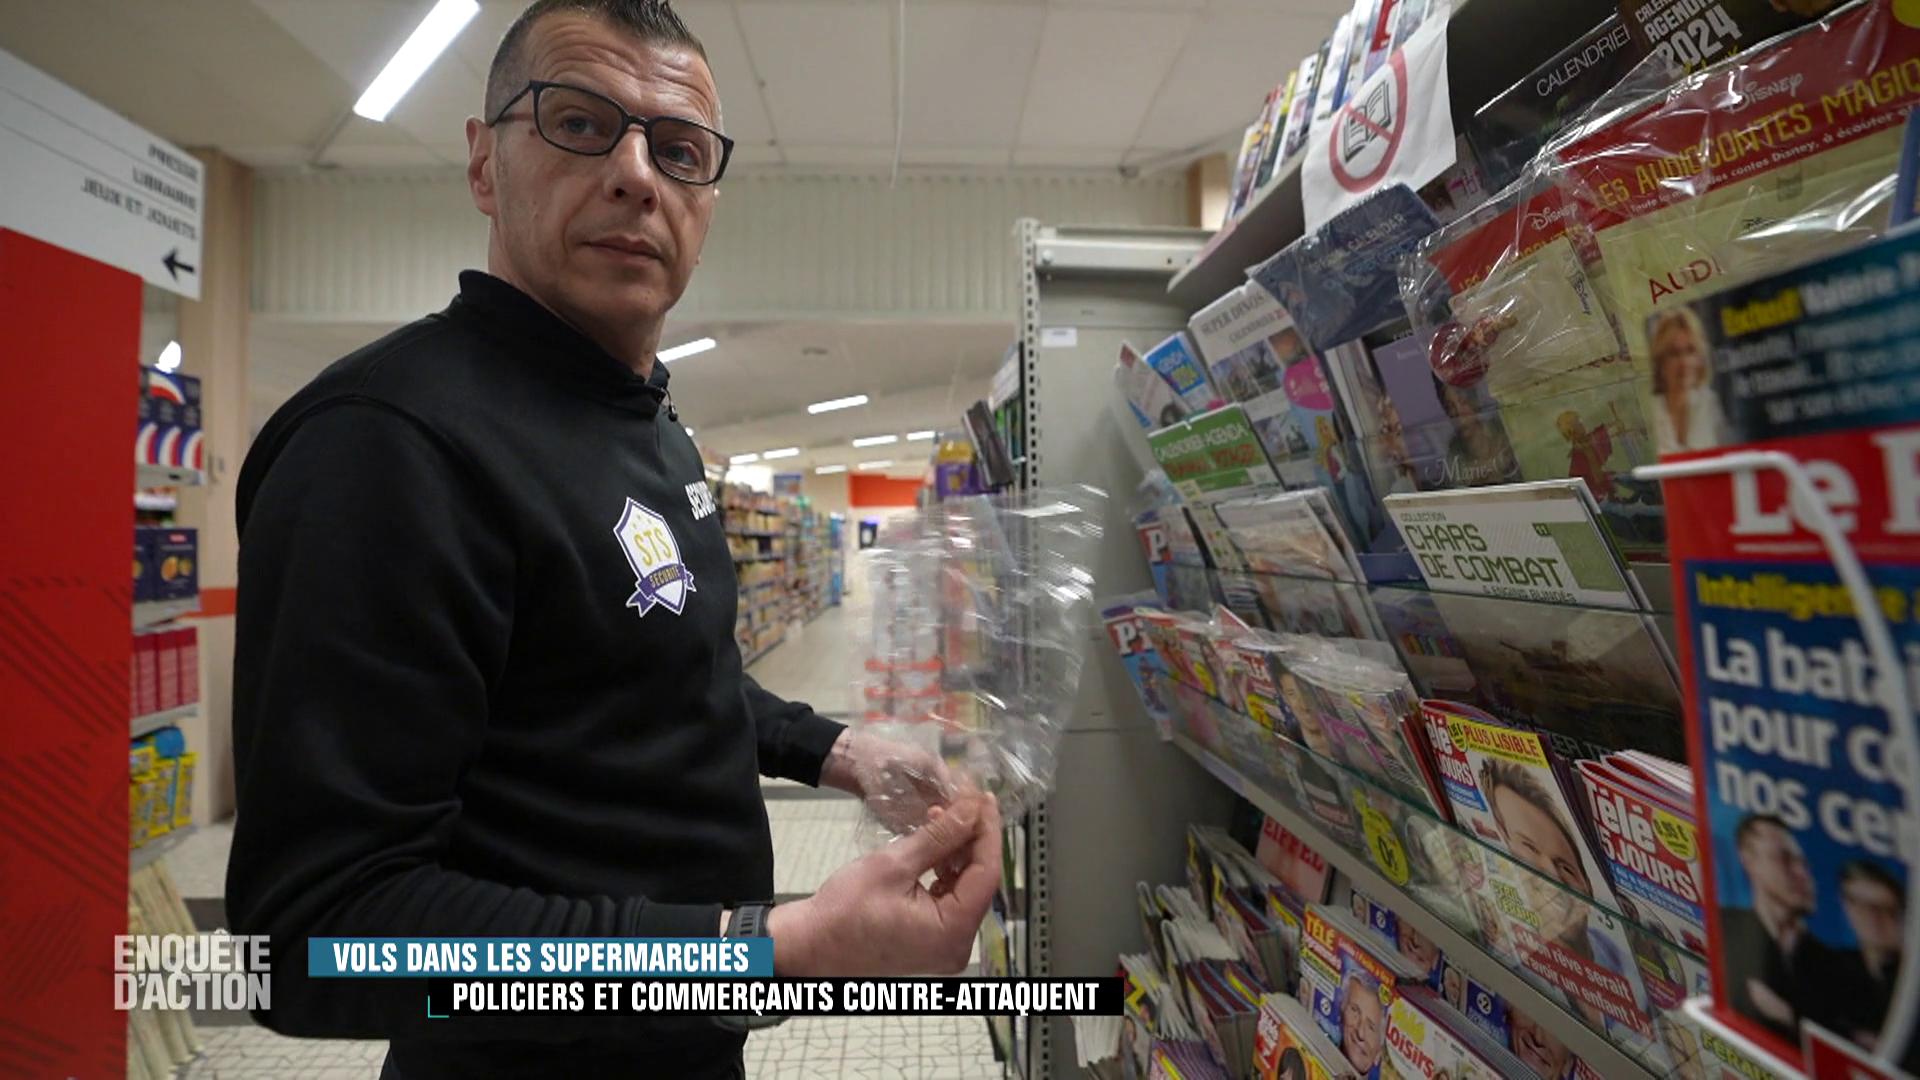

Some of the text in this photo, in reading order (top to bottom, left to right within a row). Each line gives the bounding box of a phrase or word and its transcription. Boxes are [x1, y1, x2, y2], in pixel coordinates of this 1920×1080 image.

[1656, 4, 1743, 78] 2024
[81, 177, 122, 206] JEUX
[125, 195, 143, 217] ET
[632, 526, 672, 568] STS
[1404, 522, 1487, 552] CHARS
[1417, 552, 1564, 589] DE COMBAT
[1700, 621, 1764, 689] La
[1462, 723, 1491, 747] PLUS
[1490, 730, 1541, 758] LISIBLE
[1709, 695, 1840, 770] pour
[1715, 758, 1813, 832] nos
[1615, 838, 1699, 904] JOURS
[1552, 946, 1584, 977] rêve
[1583, 965, 1633, 1001] serait
[1560, 974, 1580, 995] un
[1582, 988, 1631, 1026] enfant
